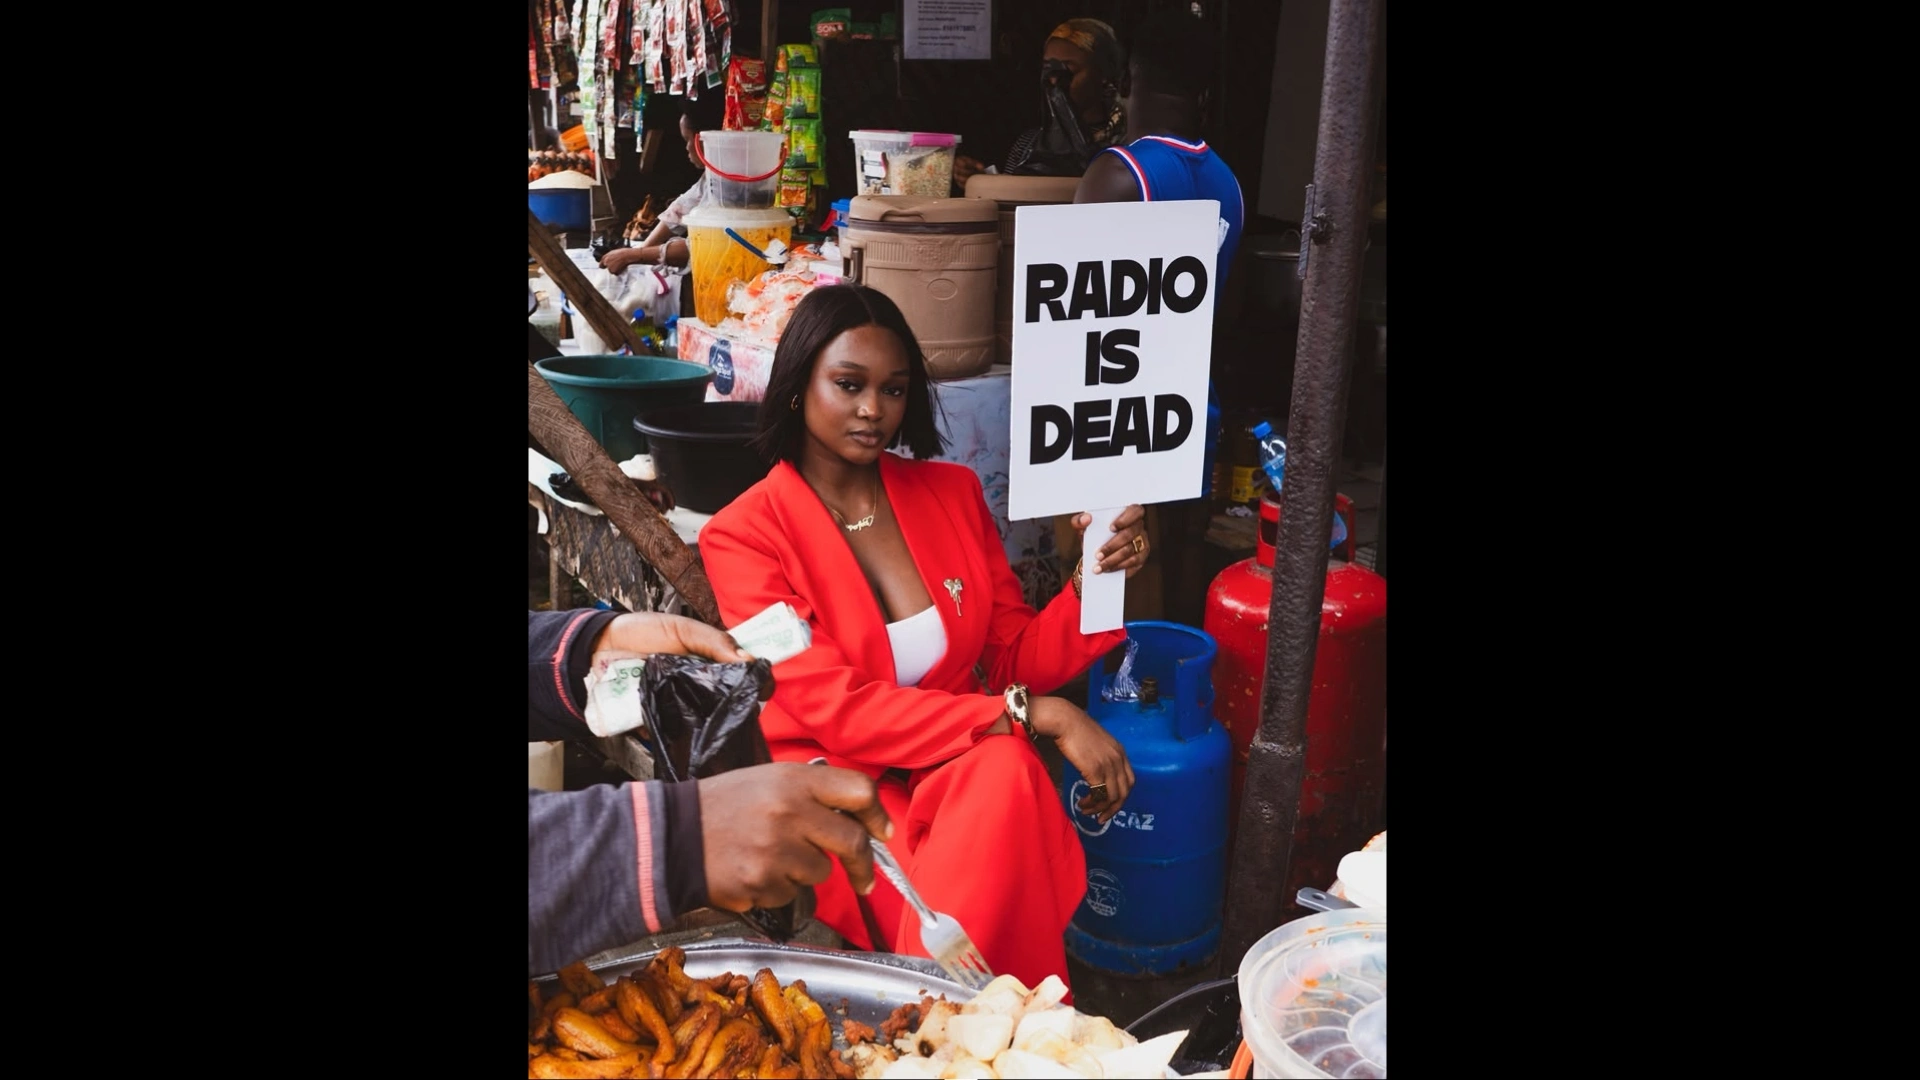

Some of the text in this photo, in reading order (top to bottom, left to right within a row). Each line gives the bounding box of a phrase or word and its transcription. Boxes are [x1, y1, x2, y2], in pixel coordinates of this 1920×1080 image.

[1025, 255, 1208, 324] RADIO
[1084, 328, 1141, 387] IS
[1029, 393, 1194, 465] DEAD
